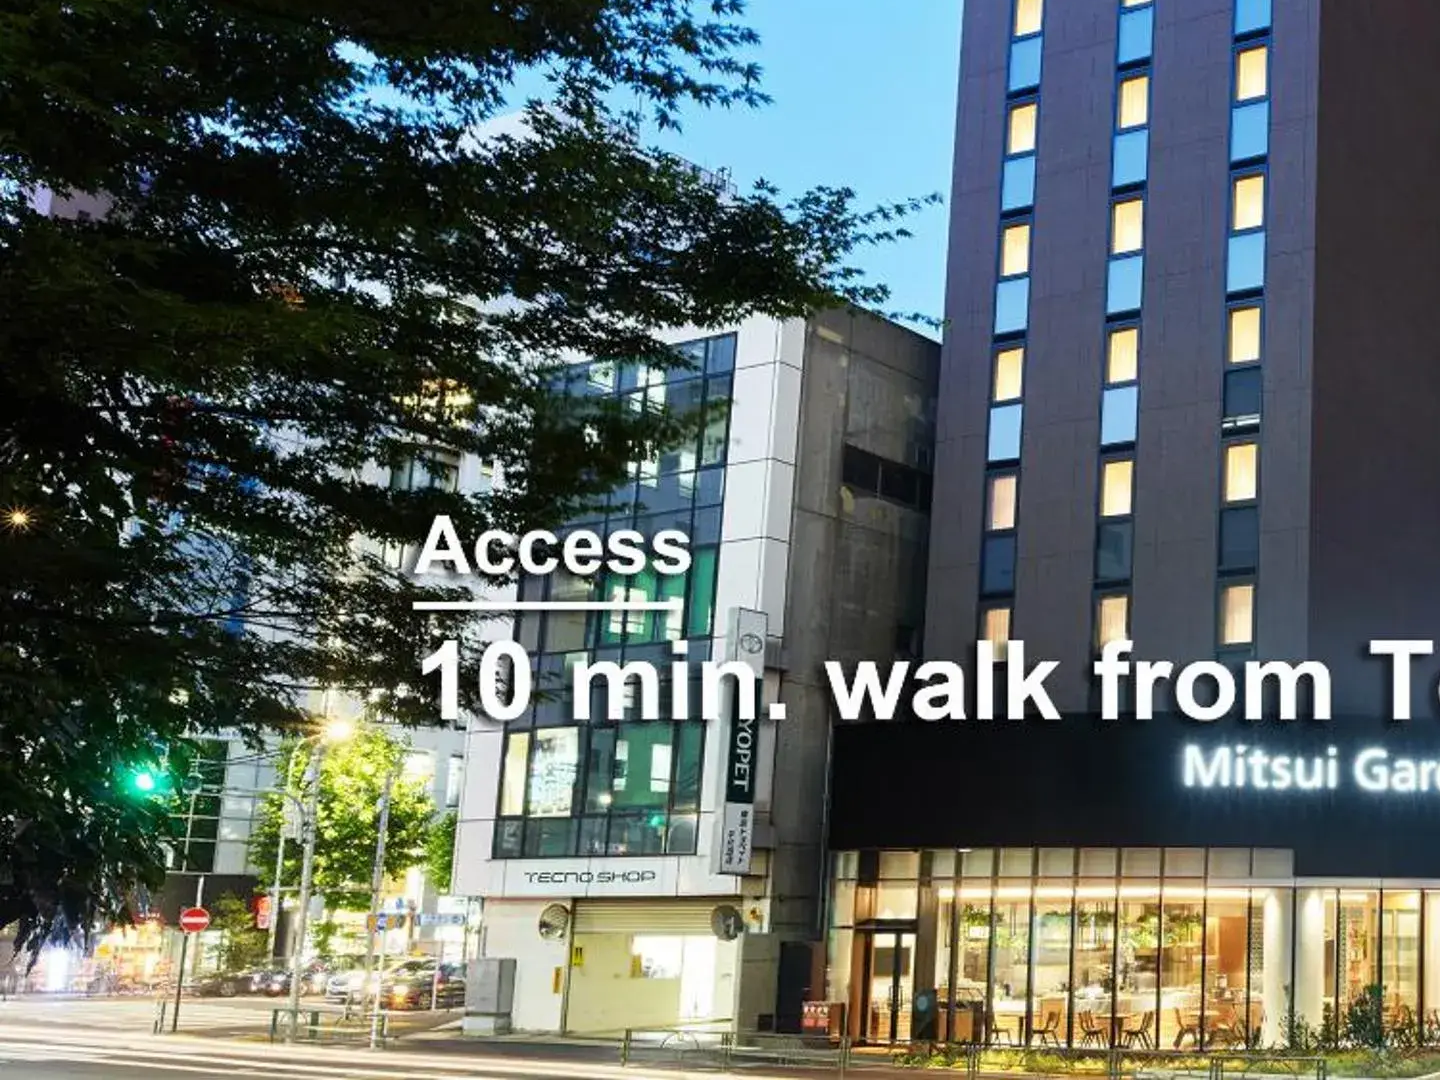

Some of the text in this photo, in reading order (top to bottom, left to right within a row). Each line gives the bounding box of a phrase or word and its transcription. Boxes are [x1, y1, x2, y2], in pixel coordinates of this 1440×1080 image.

[733, 718, 753, 793] YOPET
[1182, 743, 1338, 790] Mitsui
[524, 870, 656, 883] TECNO SHOP
